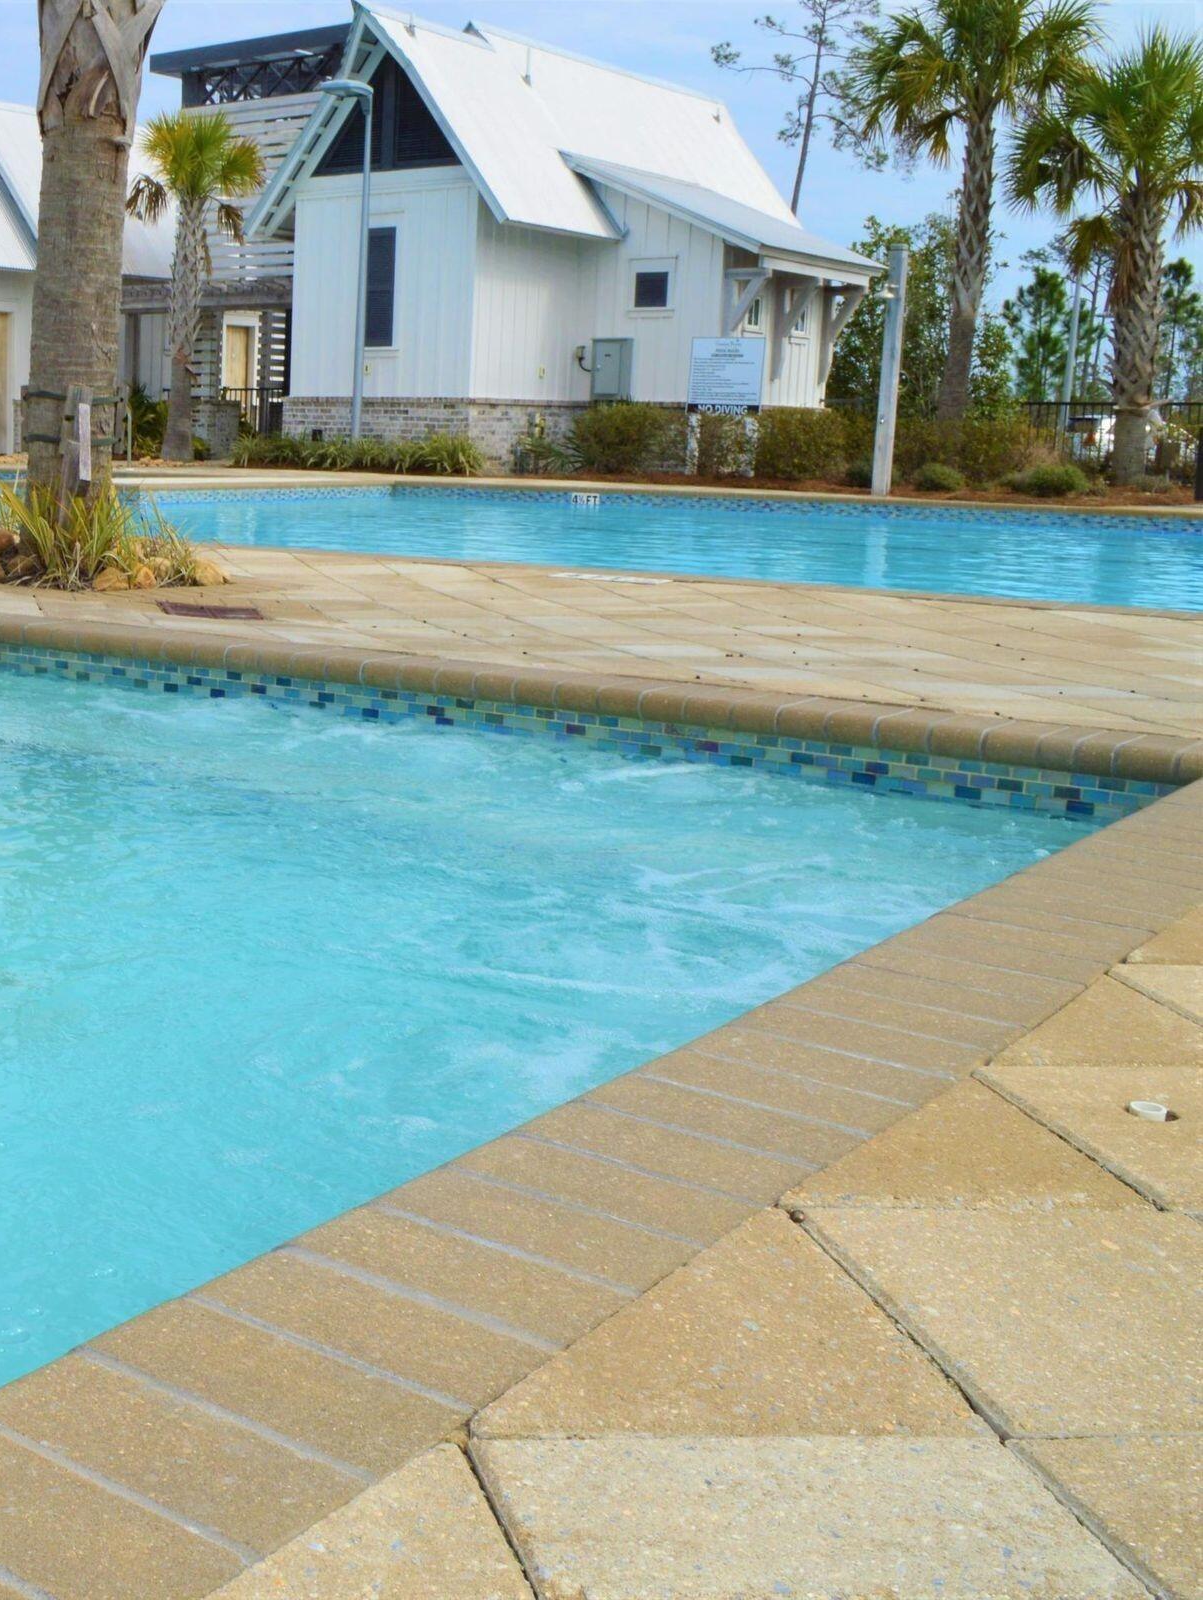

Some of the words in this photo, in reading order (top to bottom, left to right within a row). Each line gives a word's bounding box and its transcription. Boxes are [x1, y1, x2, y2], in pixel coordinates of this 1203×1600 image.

[697, 404, 713, 415] NO
[715, 404, 749, 416] DIVING
[586, 494, 598, 505] FT
